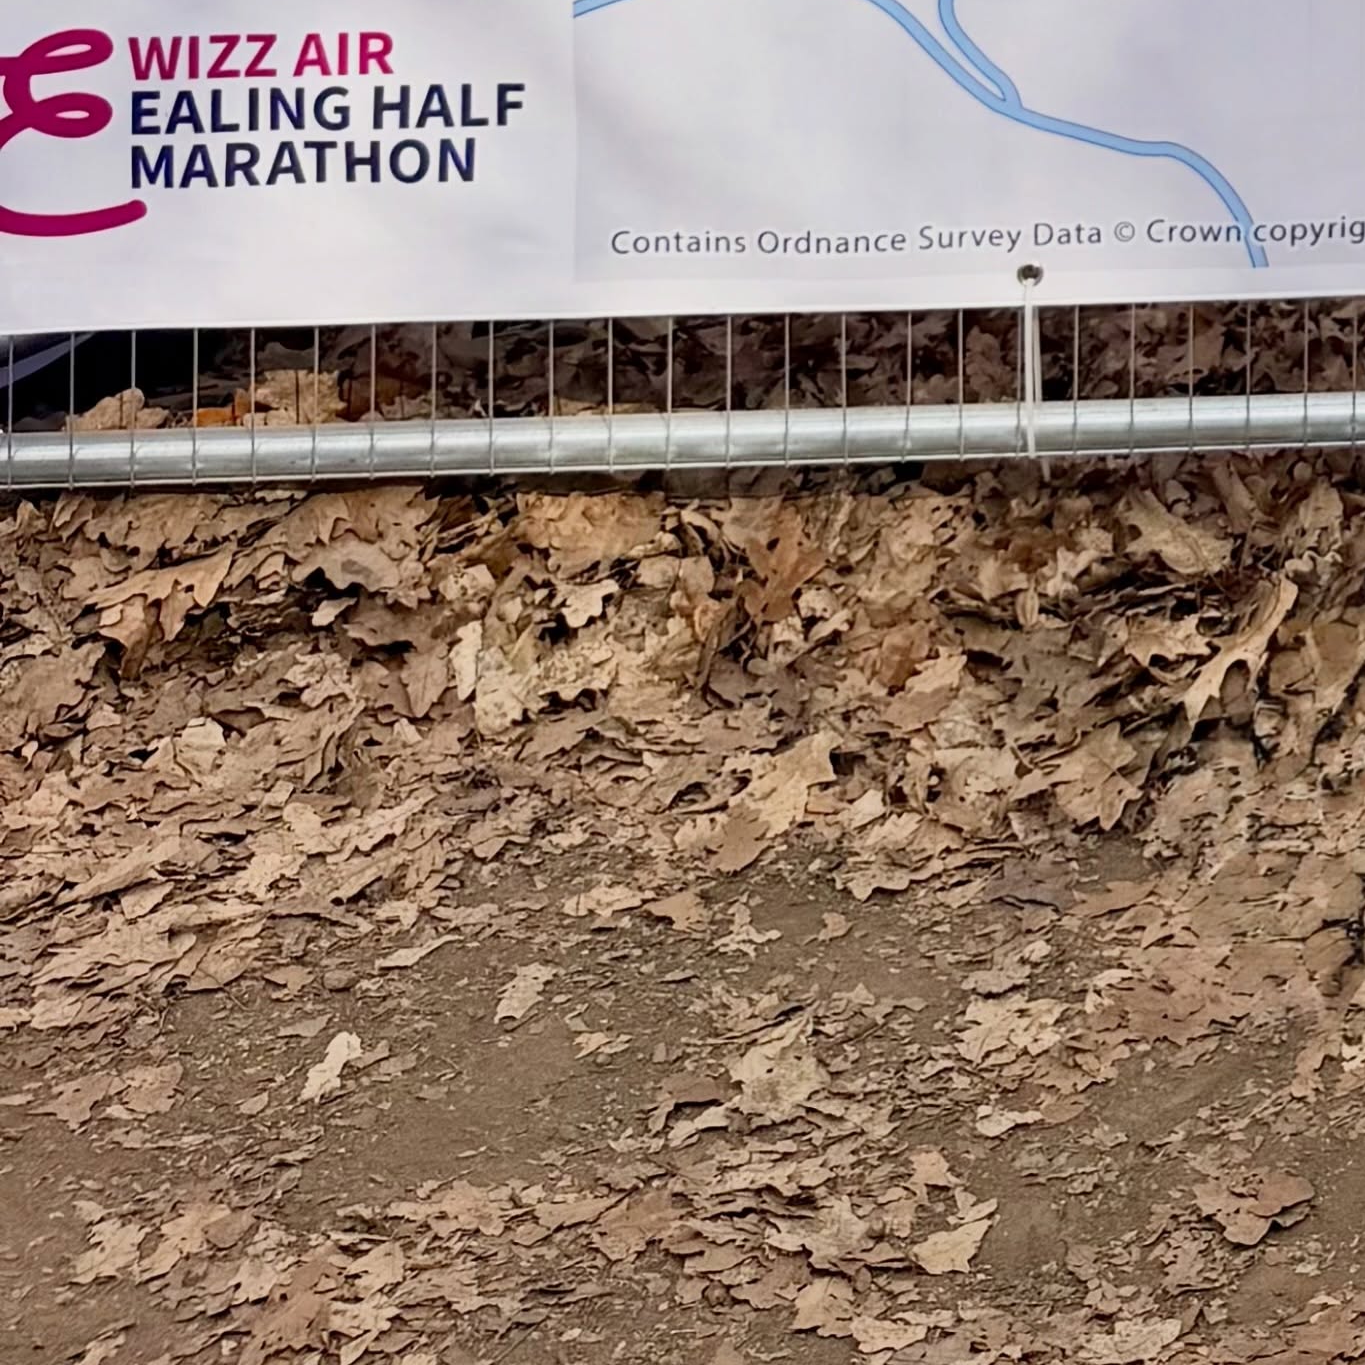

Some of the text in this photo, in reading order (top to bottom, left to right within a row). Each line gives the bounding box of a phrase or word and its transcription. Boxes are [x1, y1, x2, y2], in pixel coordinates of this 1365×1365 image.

[611, 231, 746, 255] Contains
[757, 231, 906, 254] Ordnance
[919, 226, 1022, 252] Survey
[1033, 222, 1101, 247] Data
[1147, 223, 1241, 246] Crown
